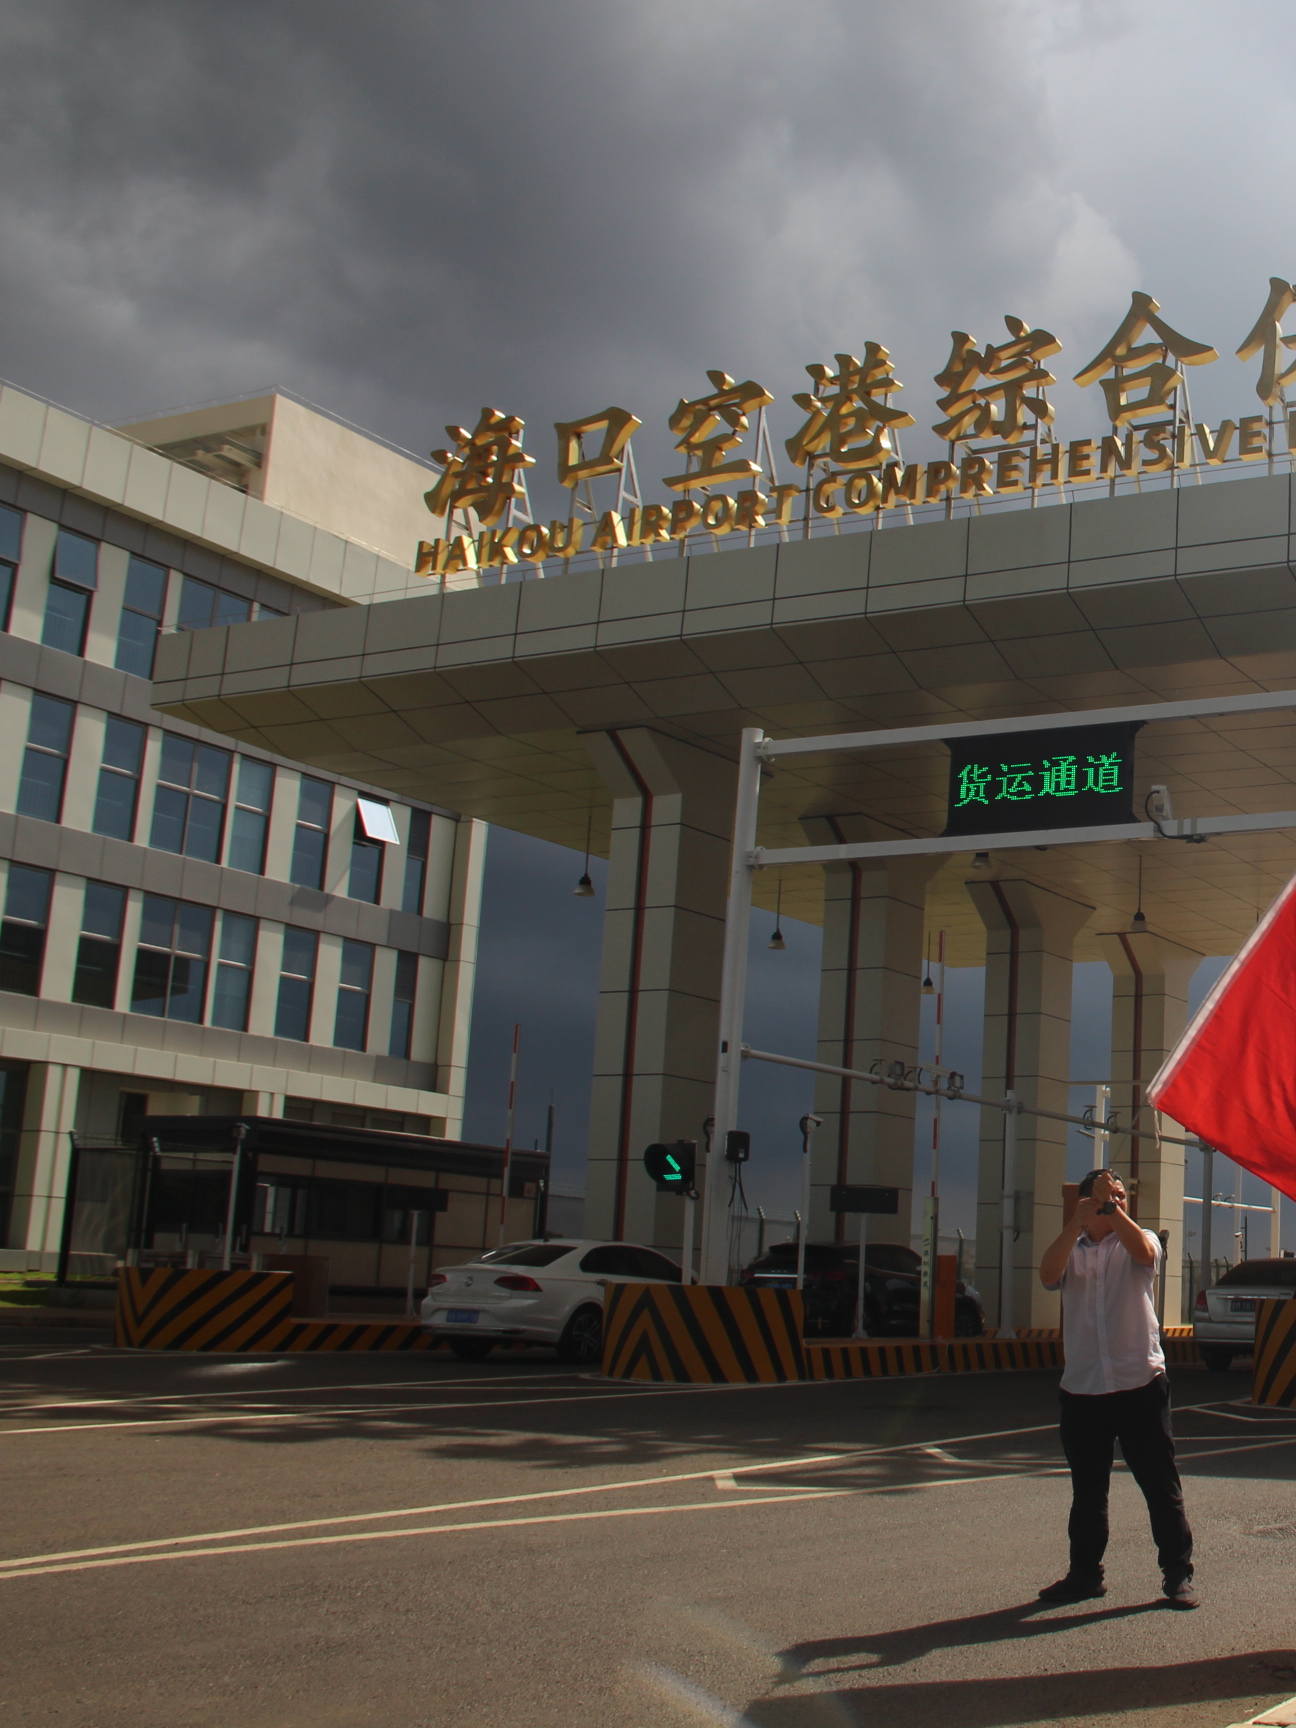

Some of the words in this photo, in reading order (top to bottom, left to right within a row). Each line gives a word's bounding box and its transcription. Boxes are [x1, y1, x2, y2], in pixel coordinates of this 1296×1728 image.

[415, 517, 584, 578] HAIKOU
[590, 483, 800, 553] AIRPORT
[812, 415, 1269, 519] COMPREHENSIVE
[954, 752, 1123, 807] 货运通道
